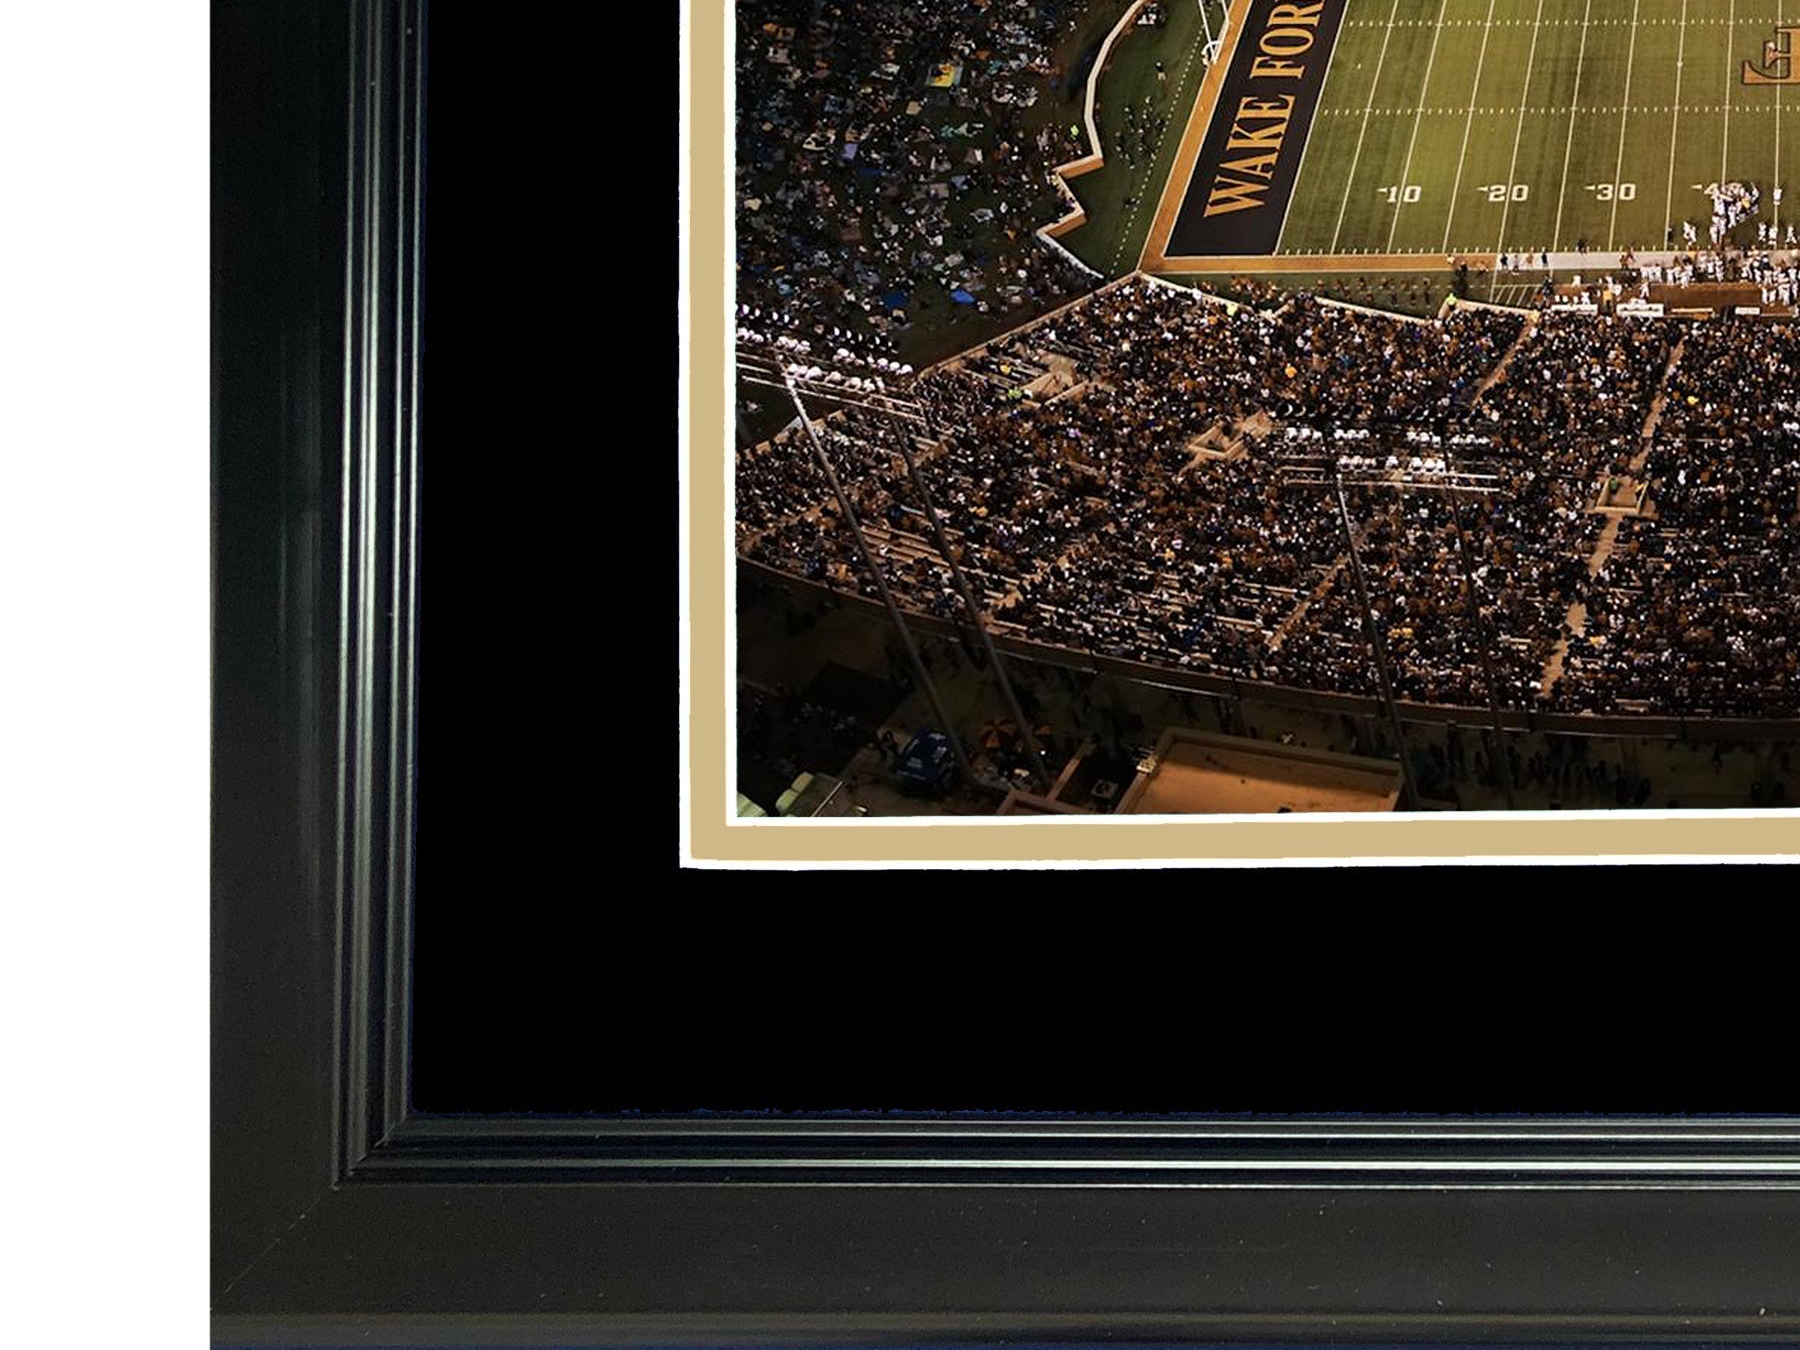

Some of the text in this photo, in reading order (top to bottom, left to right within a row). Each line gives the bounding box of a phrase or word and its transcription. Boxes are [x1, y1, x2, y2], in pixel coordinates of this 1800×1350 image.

[1203, 95, 1295, 217] WAKE
[1387, 185, 1422, 203] 10
[1489, 185, 1529, 202] 20
[1597, 183, 1636, 200] 30
